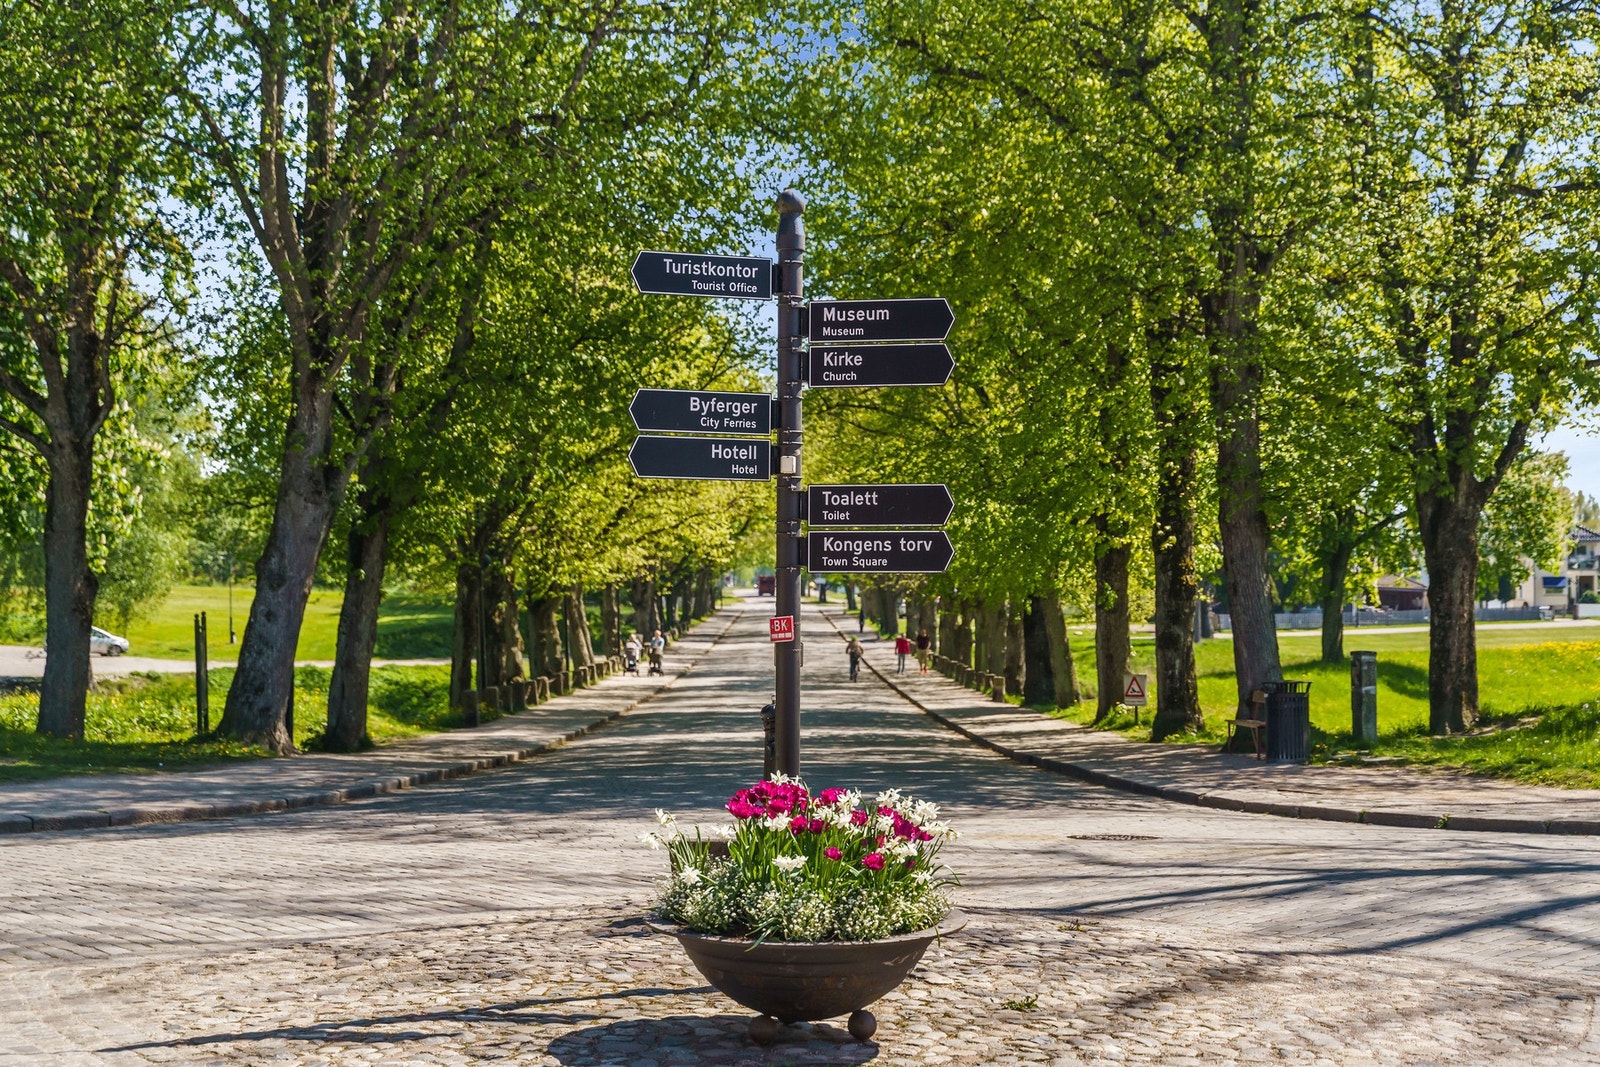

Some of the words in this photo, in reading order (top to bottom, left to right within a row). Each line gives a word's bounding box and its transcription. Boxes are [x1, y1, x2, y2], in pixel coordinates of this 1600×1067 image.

[663, 258, 759, 278] Turistkontor
[691, 279, 726, 292] Tourist
[728, 281, 758, 294] Office
[823, 306, 890, 322] Museum
[822, 326, 864, 337] Museum
[823, 352, 863, 367] Kirke
[822, 371, 857, 382] Church
[689, 396, 758, 416] Byferger
[700, 416, 720, 429] City
[723, 417, 757, 429] Ferries
[711, 444, 757, 460] Hotell
[731, 464, 758, 475] Hotel
[822, 491, 878, 506] Toalett
[822, 510, 850, 521] Toilet
[823, 536, 892, 555] Kongens
[899, 537, 933, 551] torv
[822, 556, 848, 567] Town
[852, 556, 888, 568] Square
[774, 619, 788, 632] BK
